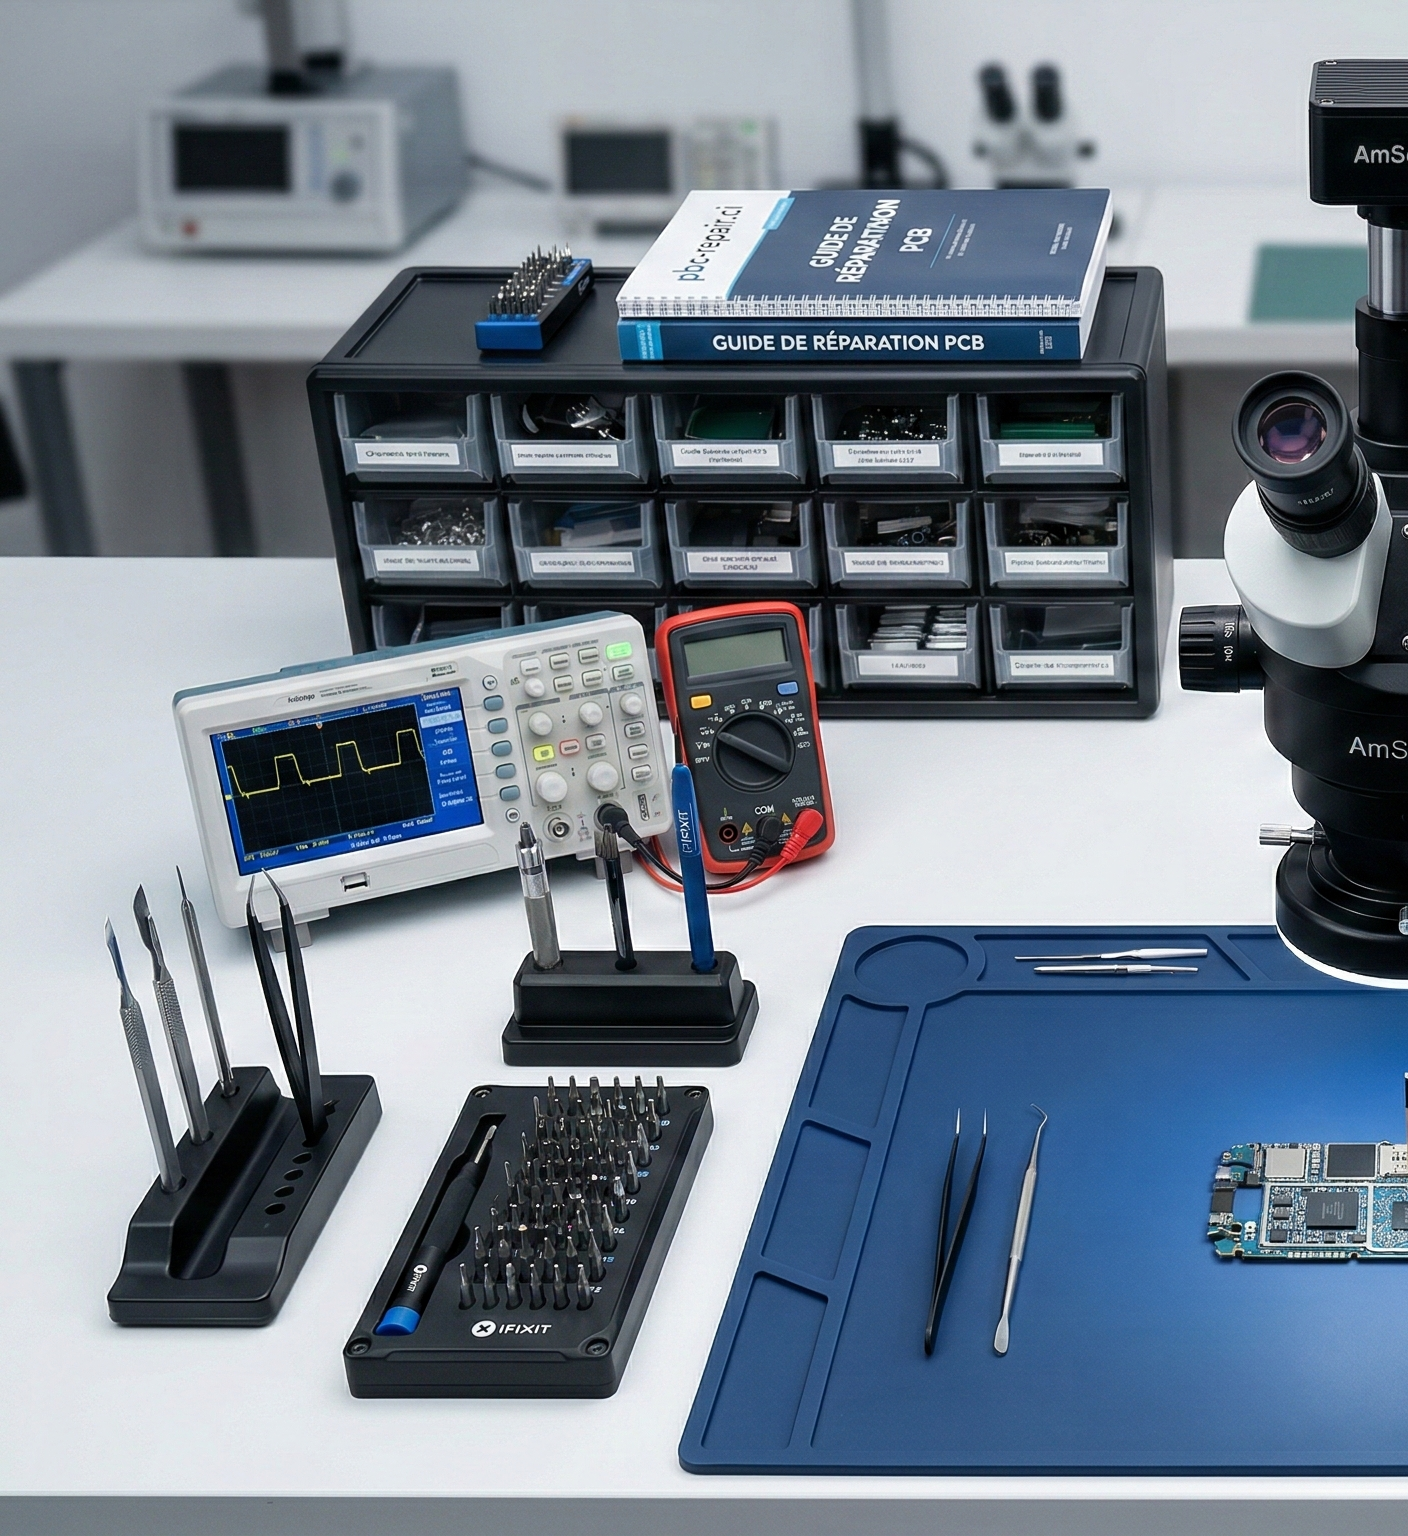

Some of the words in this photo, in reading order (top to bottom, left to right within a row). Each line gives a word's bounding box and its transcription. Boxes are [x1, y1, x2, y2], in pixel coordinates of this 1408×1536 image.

[672, 205, 744, 282] pbc-repair.ci
[808, 233, 849, 268] GUIDE
[829, 216, 859, 232] DE
[899, 228, 933, 252] PCB
[712, 334, 775, 351] GUIDE
[780, 334, 808, 351] DE
[813, 330, 939, 351] RÉPARATION
[944, 334, 985, 351] PCB
[754, 804, 775, 815] COM
[498, 1323, 552, 1335] IFIXIT
